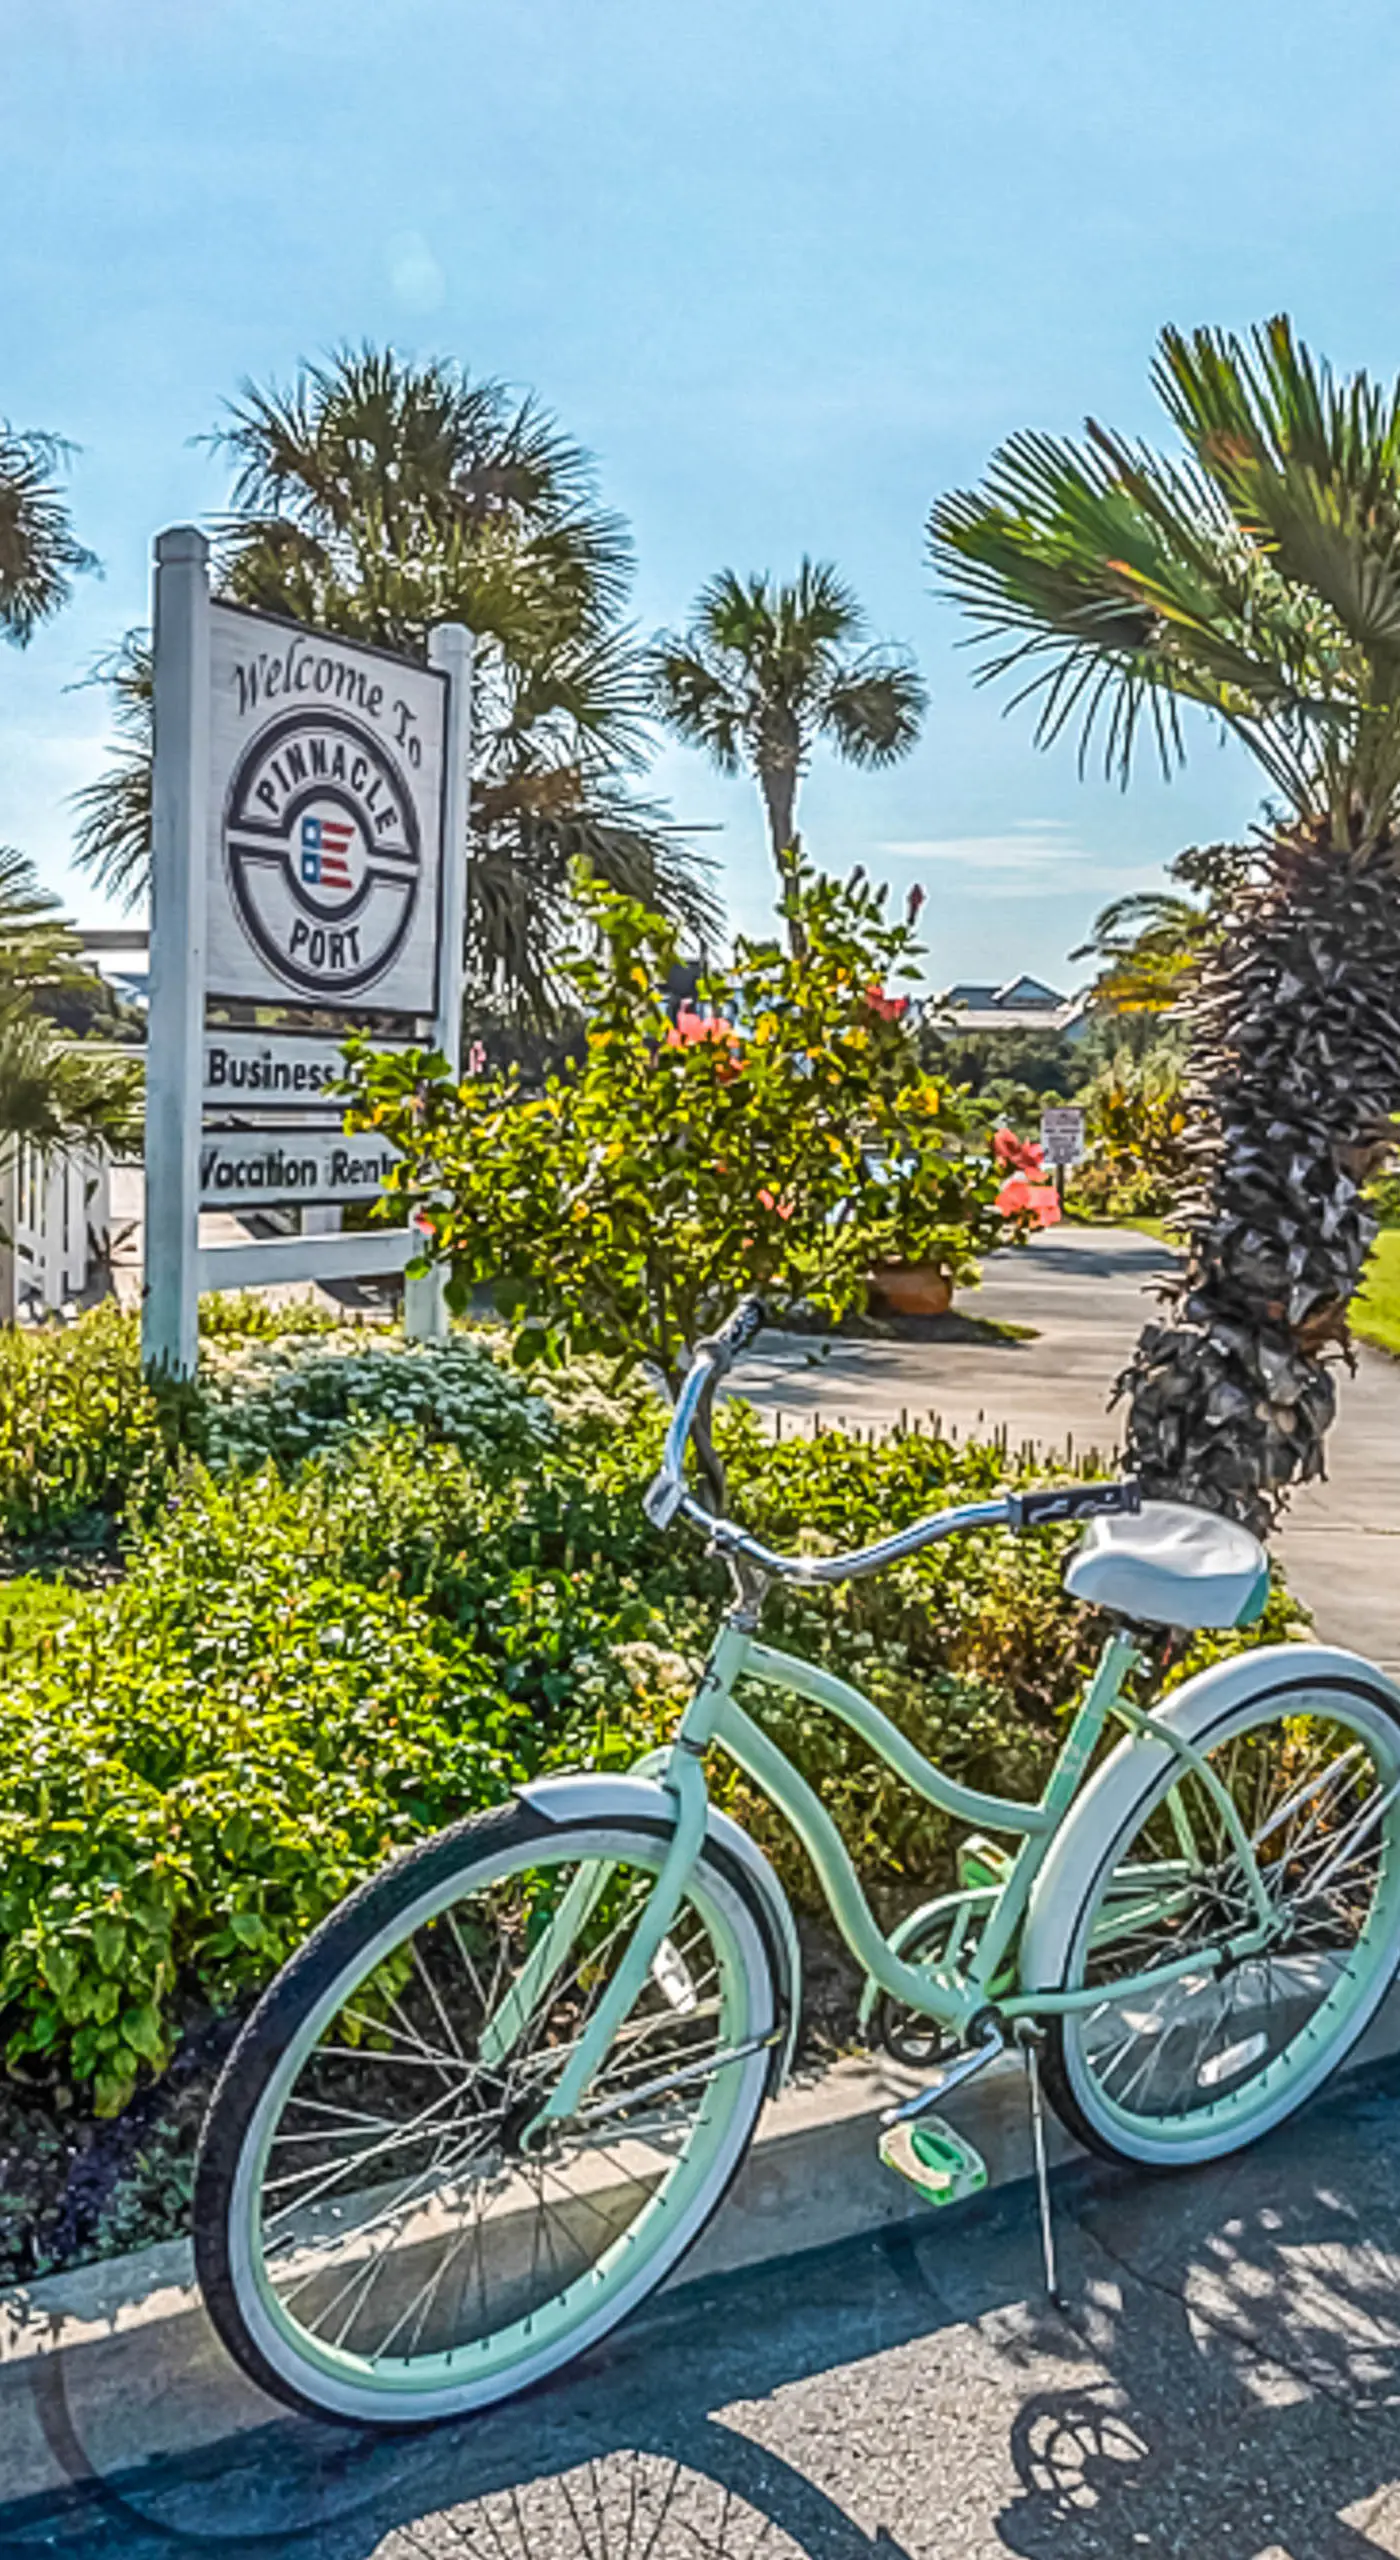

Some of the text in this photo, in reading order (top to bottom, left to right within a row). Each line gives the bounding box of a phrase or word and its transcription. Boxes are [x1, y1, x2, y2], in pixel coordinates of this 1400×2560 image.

[231, 637, 422, 769] Welcome To
[256, 738, 398, 835] PINNACLE
[289, 918, 360, 969] PORT
[208, 1049, 335, 1092] Business
